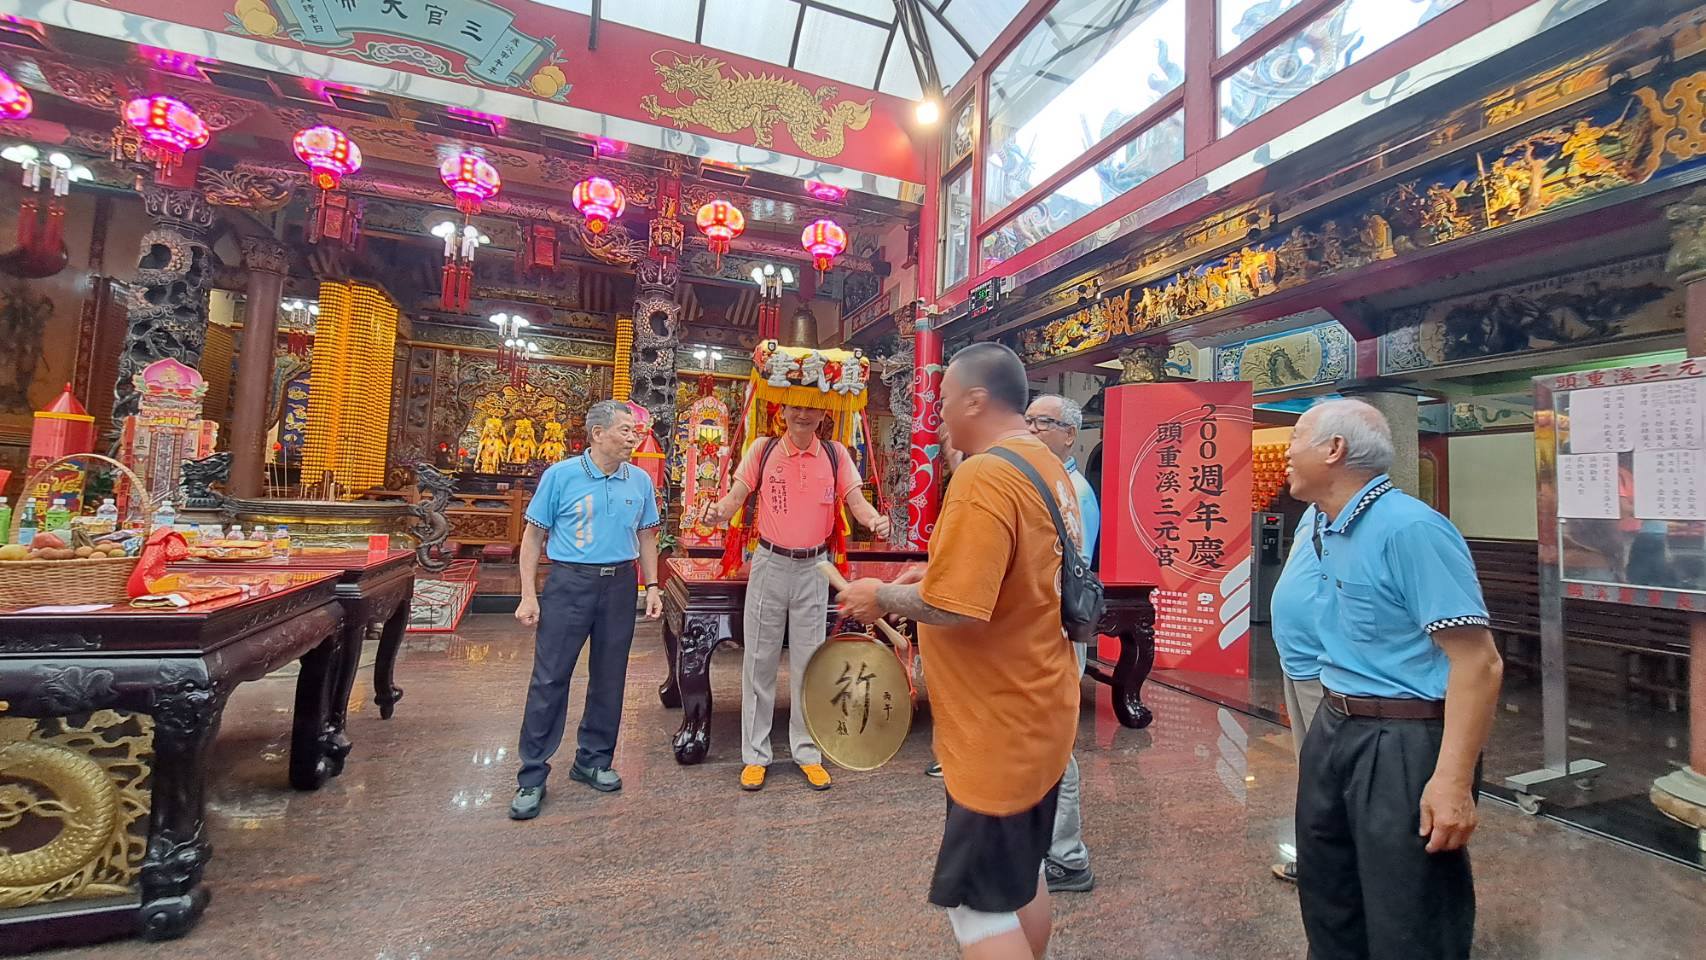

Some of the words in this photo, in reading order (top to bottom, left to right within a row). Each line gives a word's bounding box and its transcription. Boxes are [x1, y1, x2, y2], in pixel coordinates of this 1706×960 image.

[1555, 359, 1703, 389] 頭重溪三元
[1153, 422, 1184, 567] 頭重溪三元宮
[1187, 404, 1228, 569] 200週年慶
